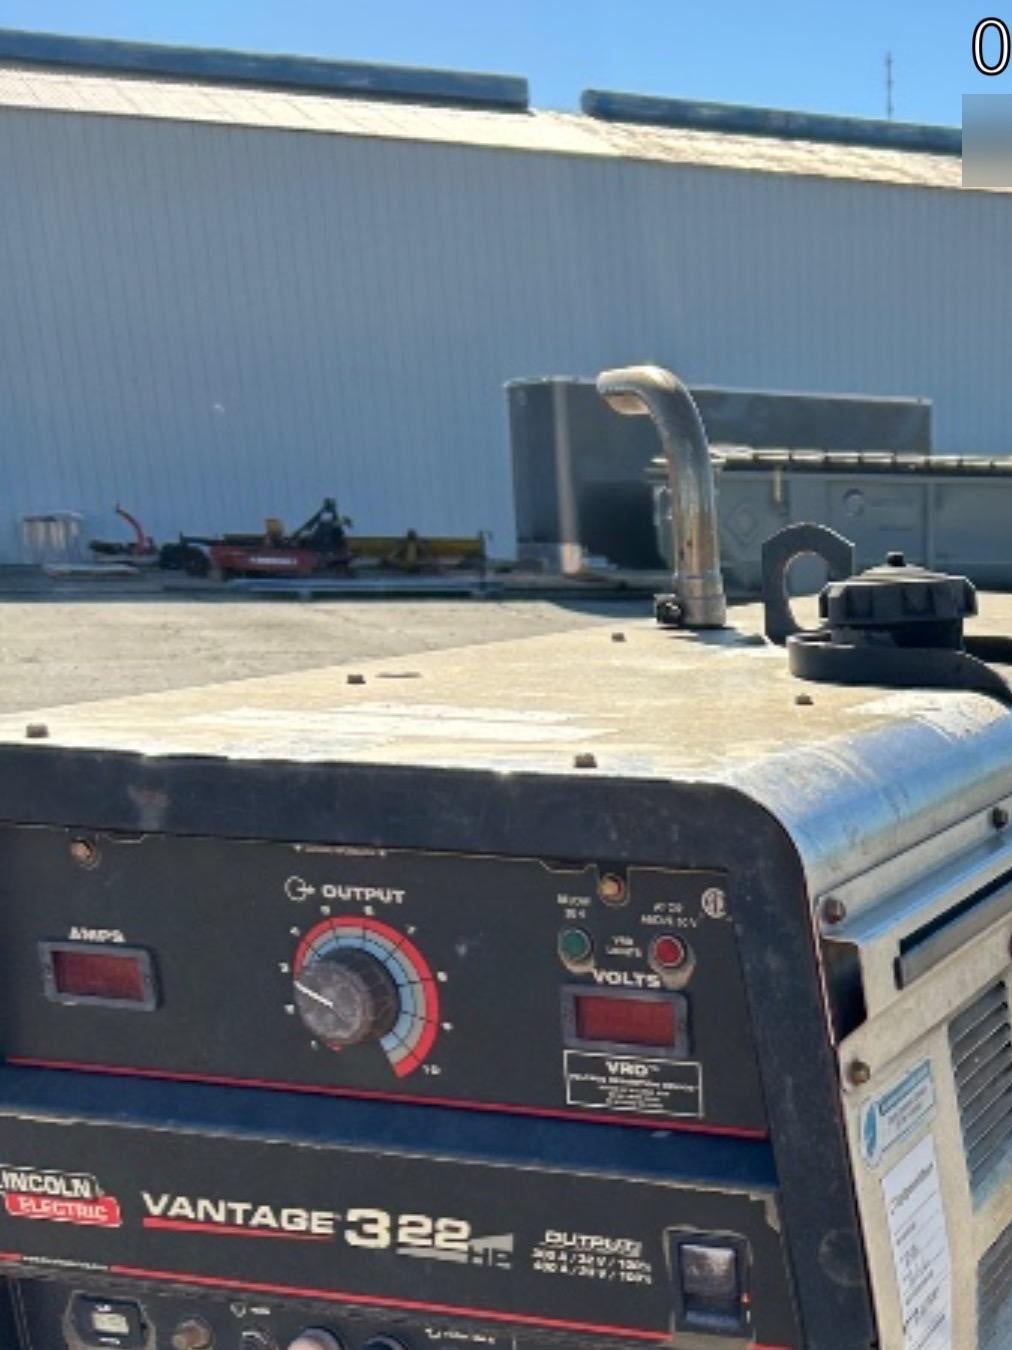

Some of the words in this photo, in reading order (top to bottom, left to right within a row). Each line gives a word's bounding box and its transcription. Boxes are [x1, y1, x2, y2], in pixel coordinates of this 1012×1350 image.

[322, 884, 405, 904] OUTPUT
[592, 969, 661, 988] VOLTS
[0, 1170, 92, 1199] INCOLN
[19, 1196, 109, 1221] ELECTRIC
[141, 1191, 335, 1234] VANTAGE
